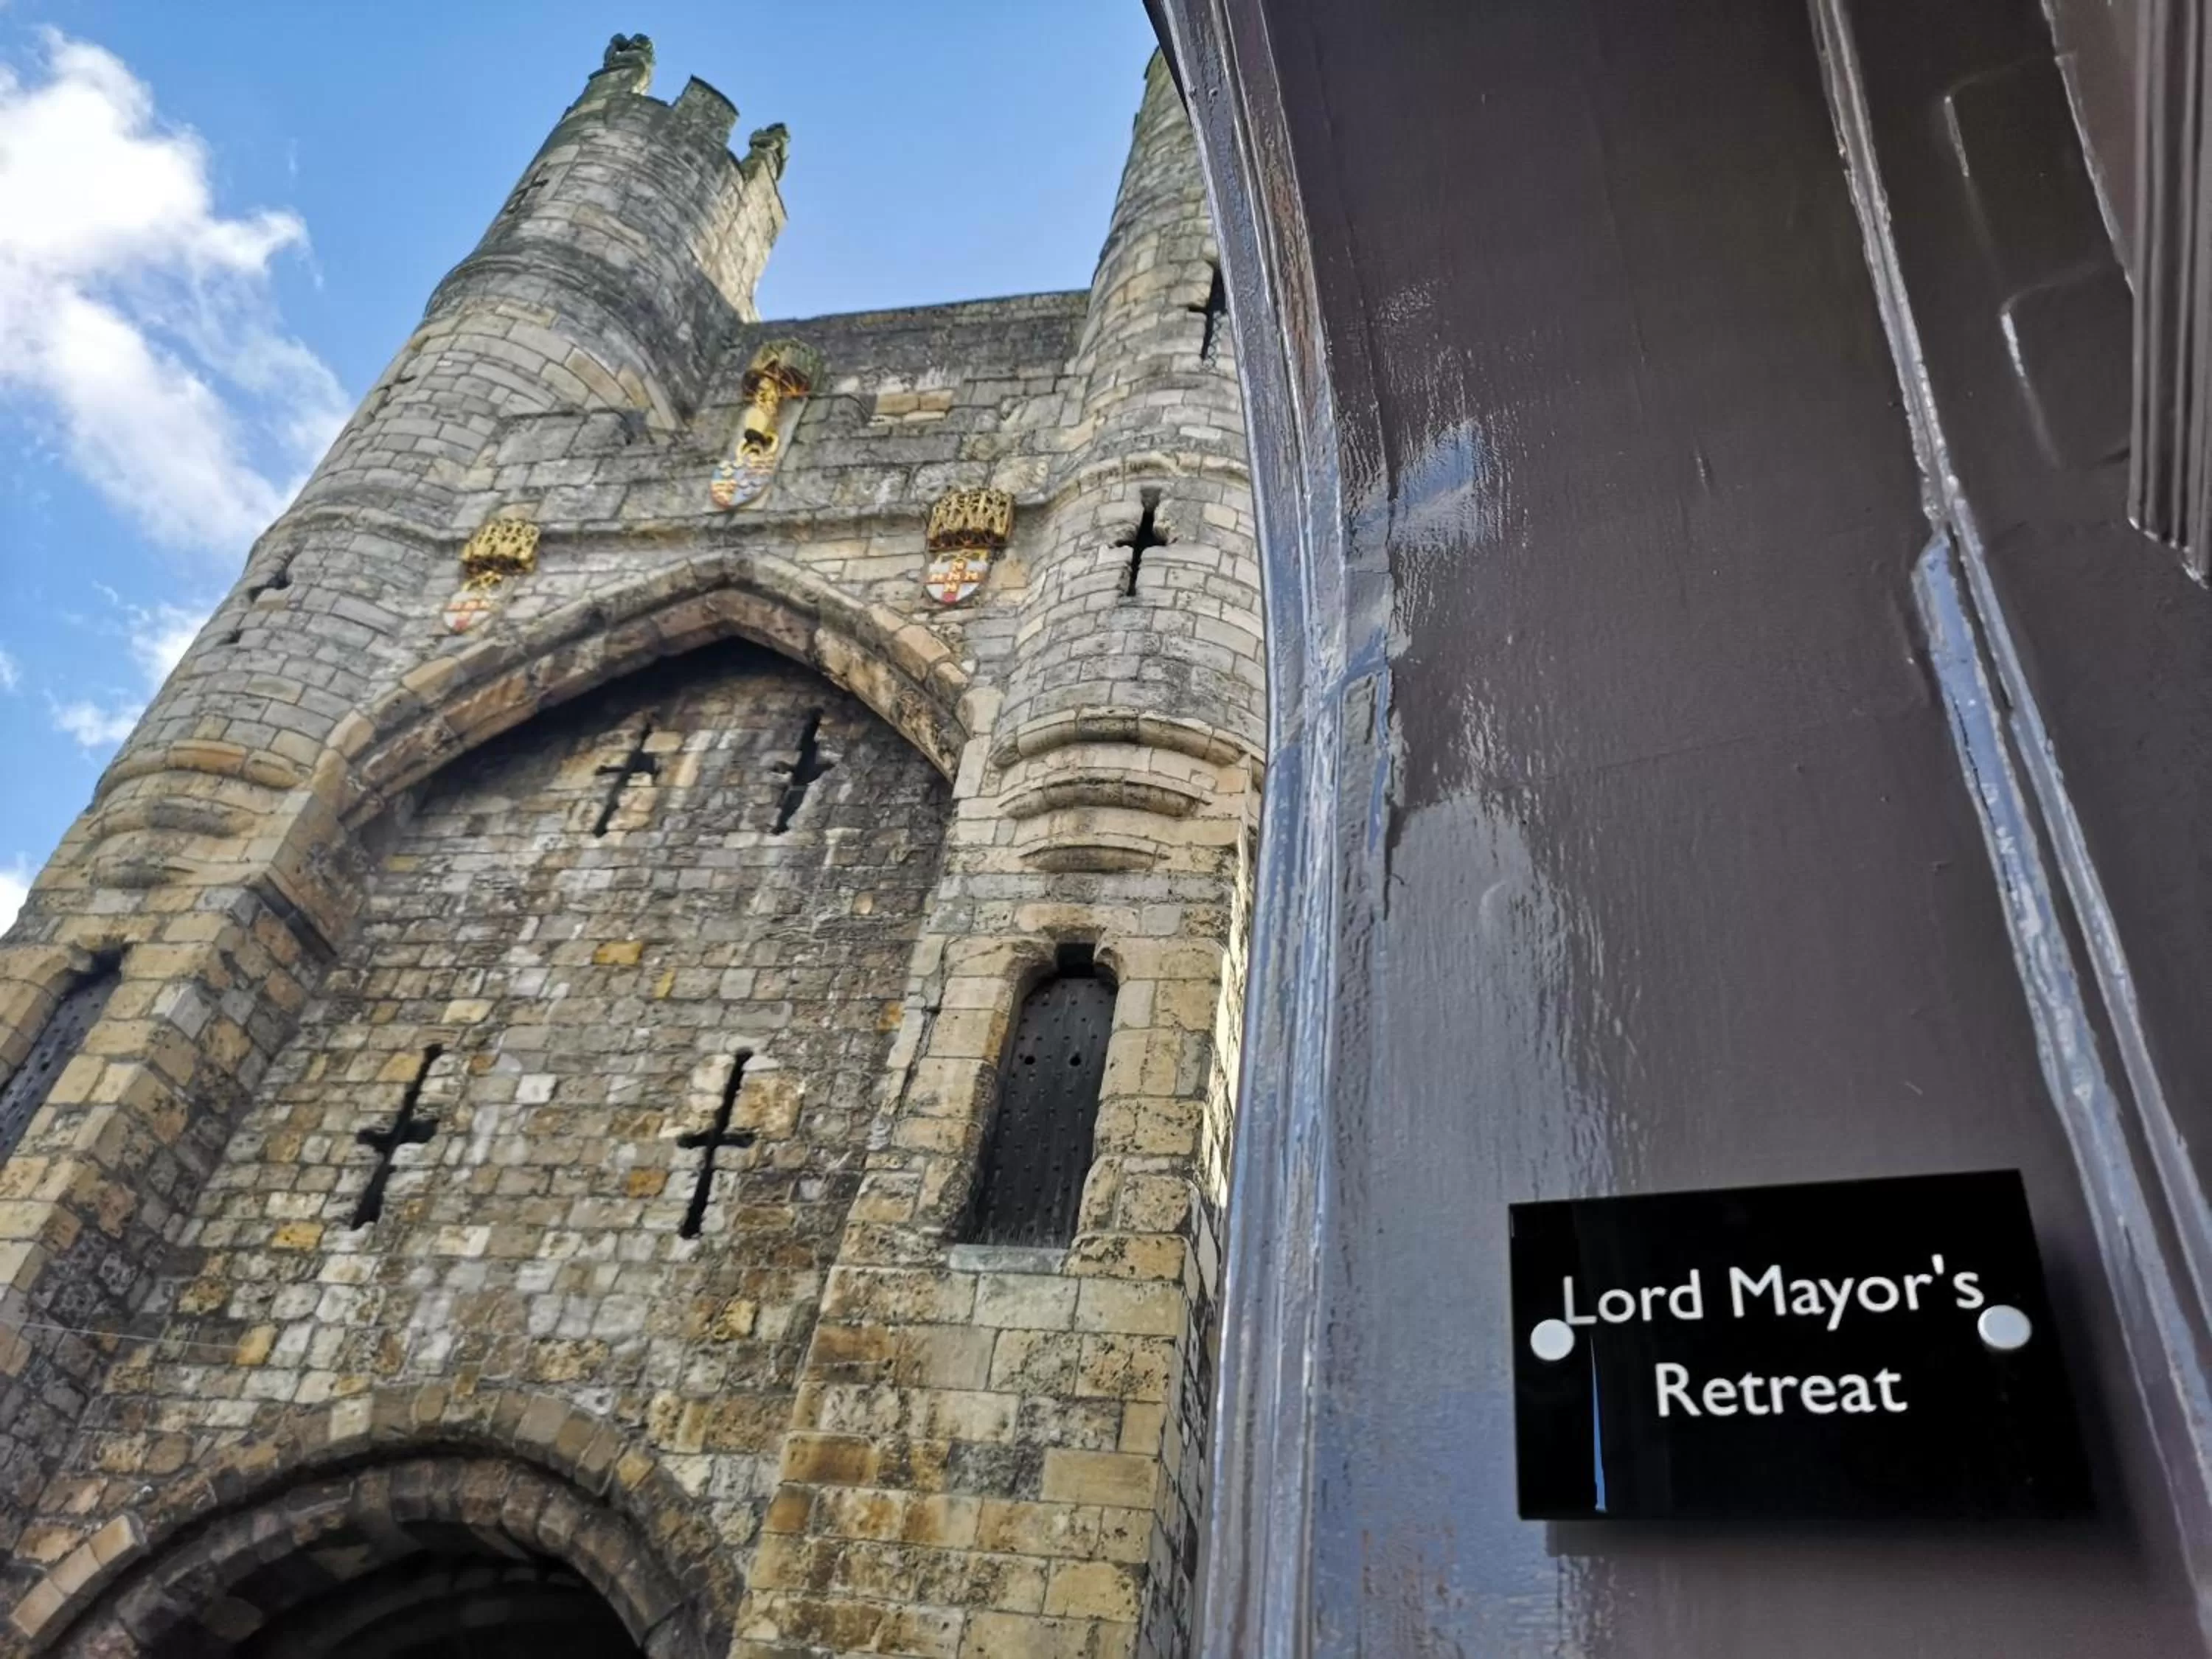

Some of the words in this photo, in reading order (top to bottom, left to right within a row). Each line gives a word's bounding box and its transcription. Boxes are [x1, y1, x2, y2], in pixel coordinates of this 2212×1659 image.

[1563, 1269, 1703, 1325] Lord
[1729, 1253, 1984, 1331] Mayor's
[1655, 1363, 1908, 1417] Retreat
